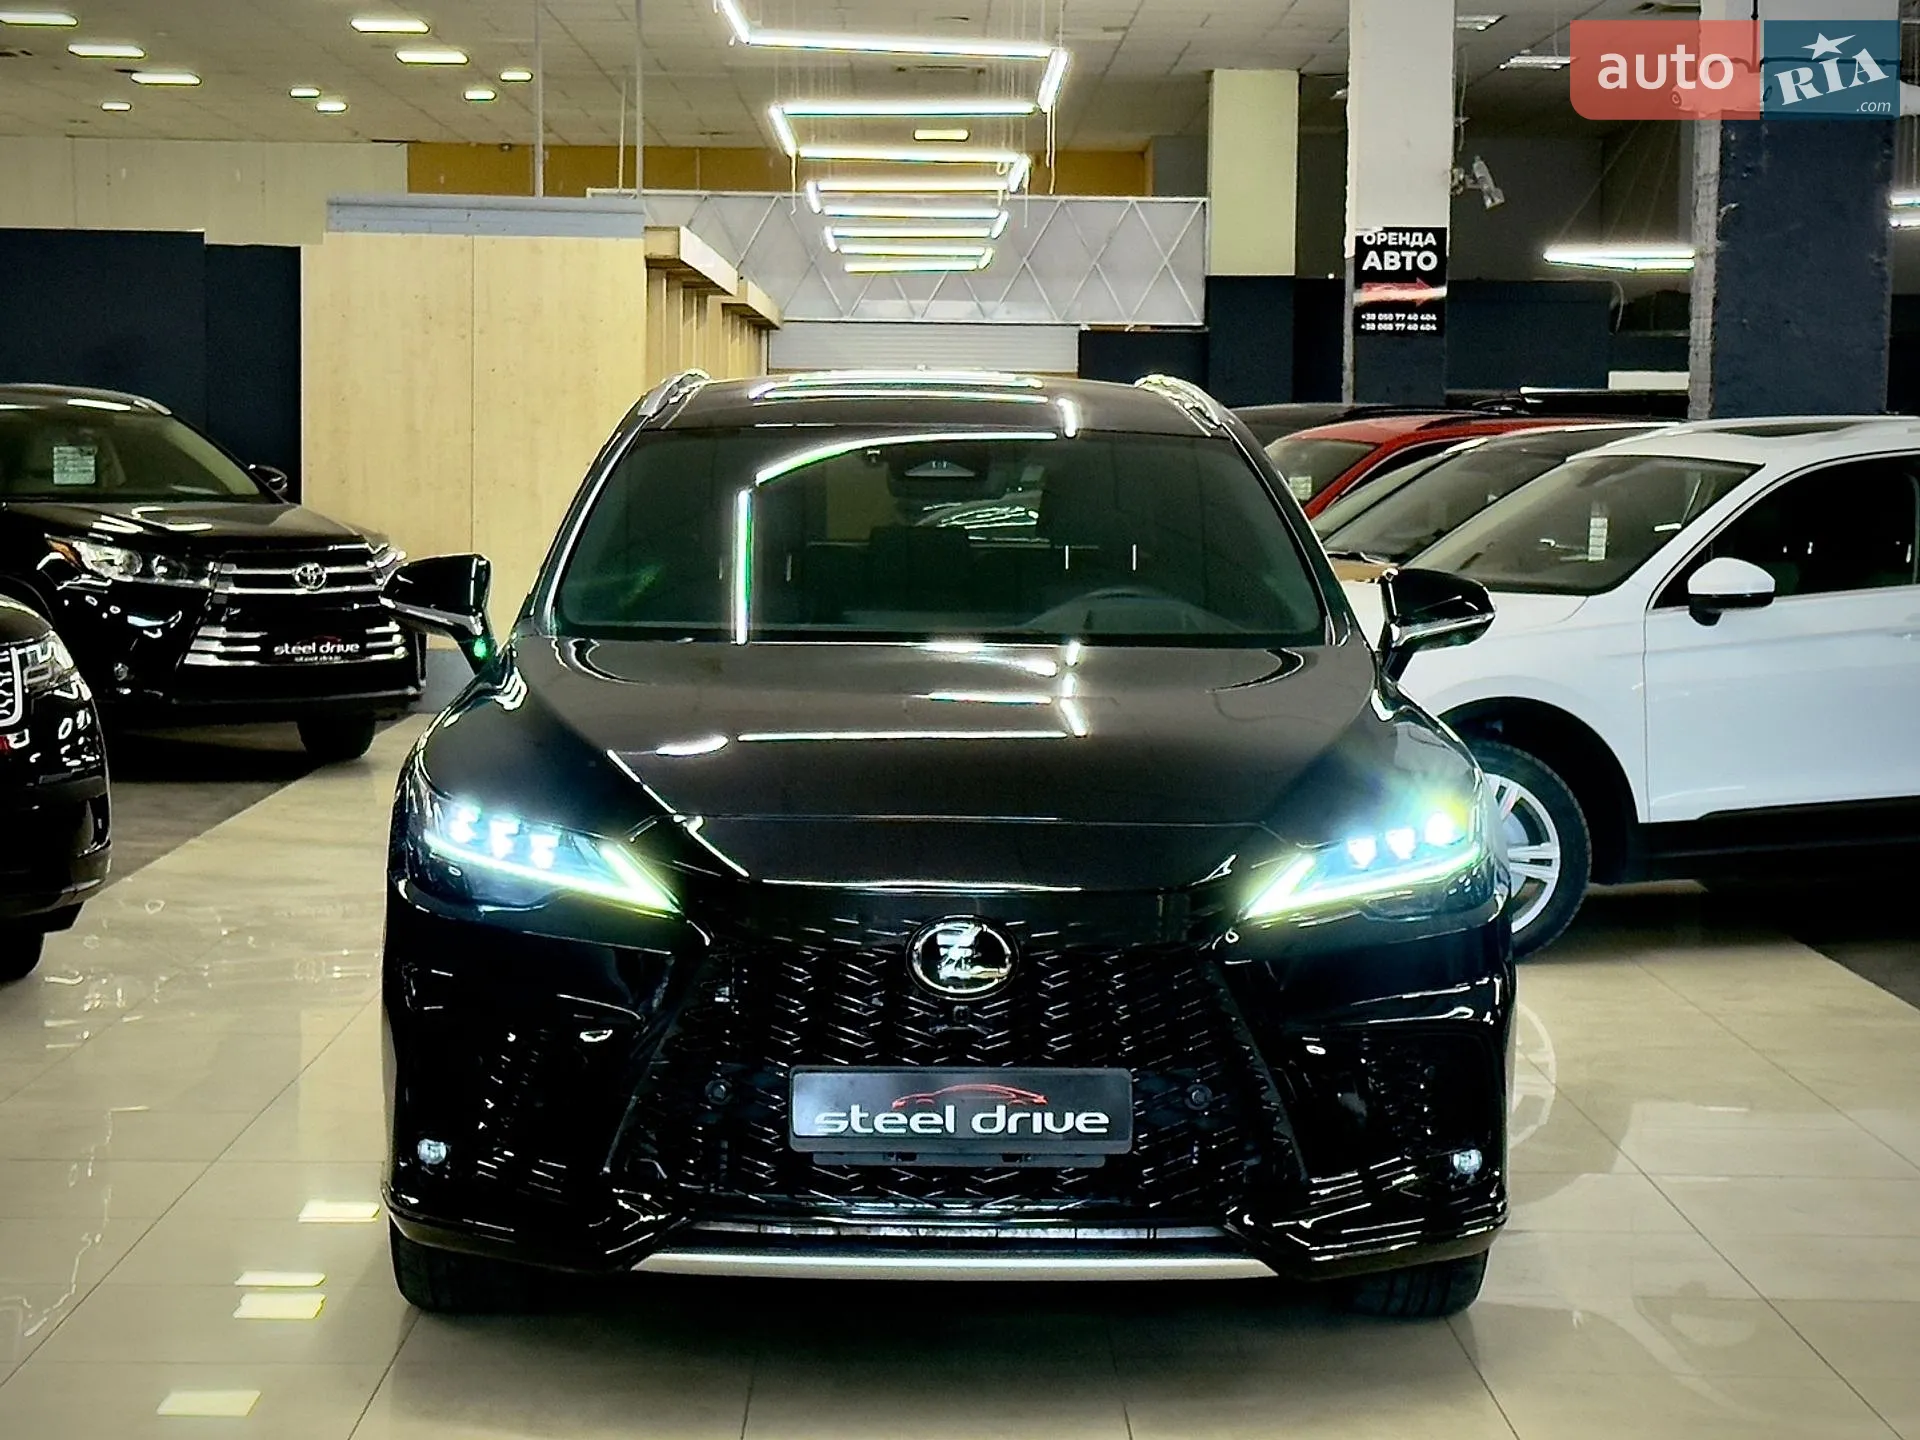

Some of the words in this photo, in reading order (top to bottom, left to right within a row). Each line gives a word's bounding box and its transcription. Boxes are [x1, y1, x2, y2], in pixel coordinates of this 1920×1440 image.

[1363, 231, 1437, 248] ОРЕНДА
[1362, 250, 1438, 271] АВТО
[1395, 313, 1406, 321] 77
[274, 642, 316, 655] steel
[319, 641, 360, 654] drive
[814, 1105, 955, 1134] steel
[971, 1104, 1110, 1134] drive
